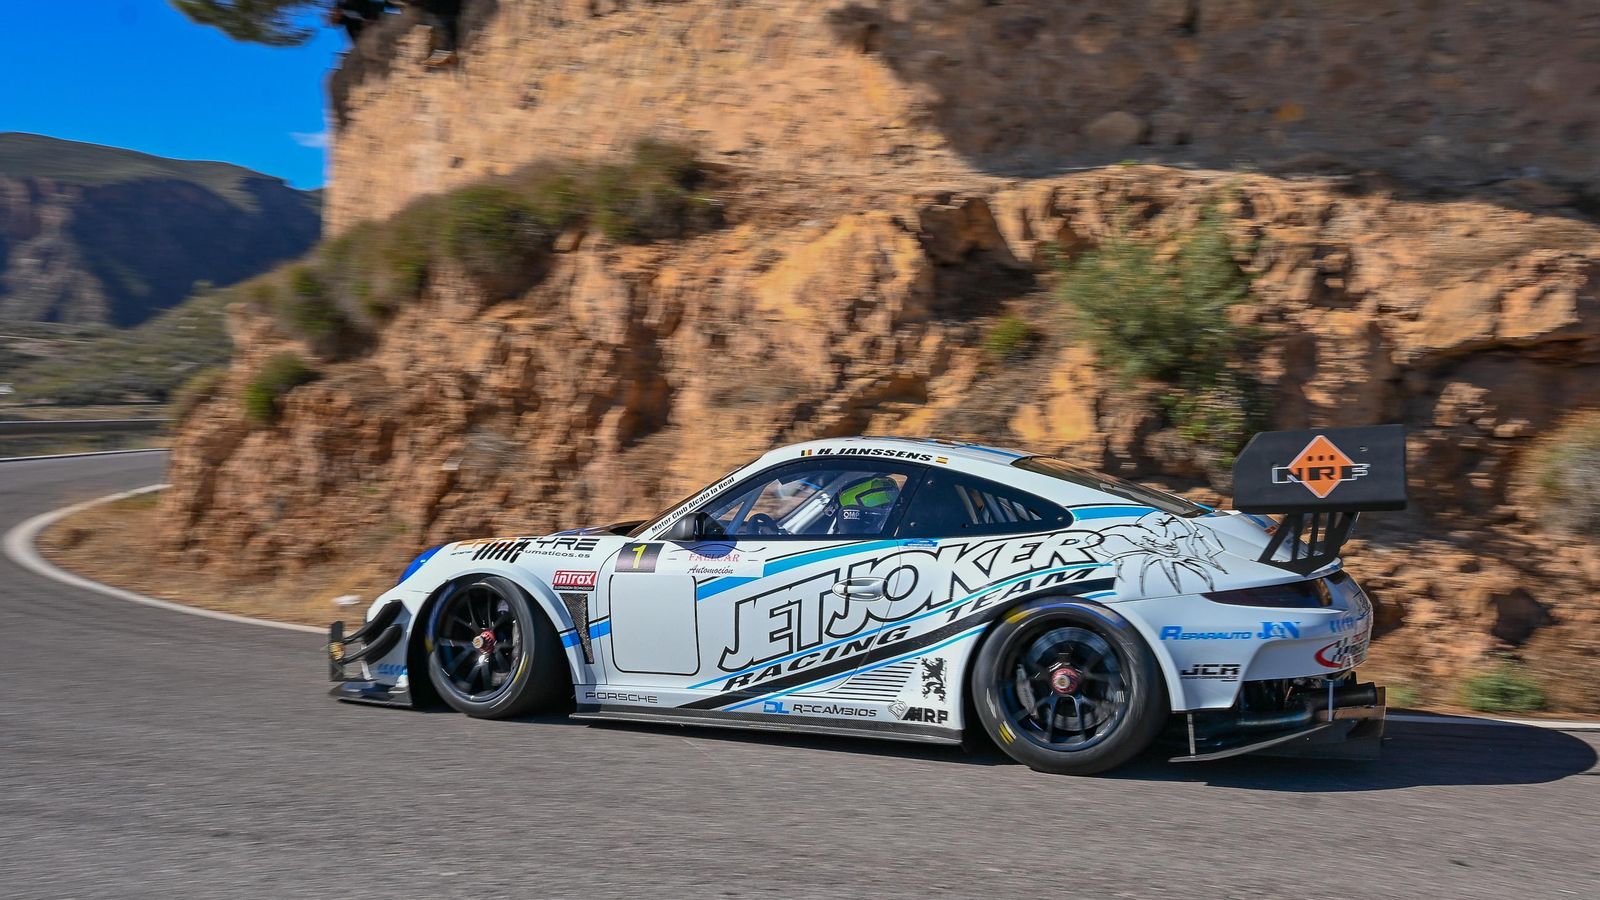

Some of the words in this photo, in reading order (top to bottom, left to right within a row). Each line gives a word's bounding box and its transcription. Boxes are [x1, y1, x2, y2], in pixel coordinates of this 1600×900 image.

[837, 448, 933, 462] JANSSENS
[1272, 463, 1371, 483] NRF
[651, 517, 671, 533] Motor
[672, 506, 688, 519] Club
[719, 477, 735, 490] Real
[843, 510, 860, 519] OMP
[631, 544, 648, 569] 1
[687, 564, 734, 575] Automoción
[720, 625, 909, 693] RACING
[944, 567, 1097, 624] TEAM
[585, 692, 658, 704] PORSCHE
[763, 700, 790, 714] DL
[792, 704, 877, 718] RECAMBIOS
